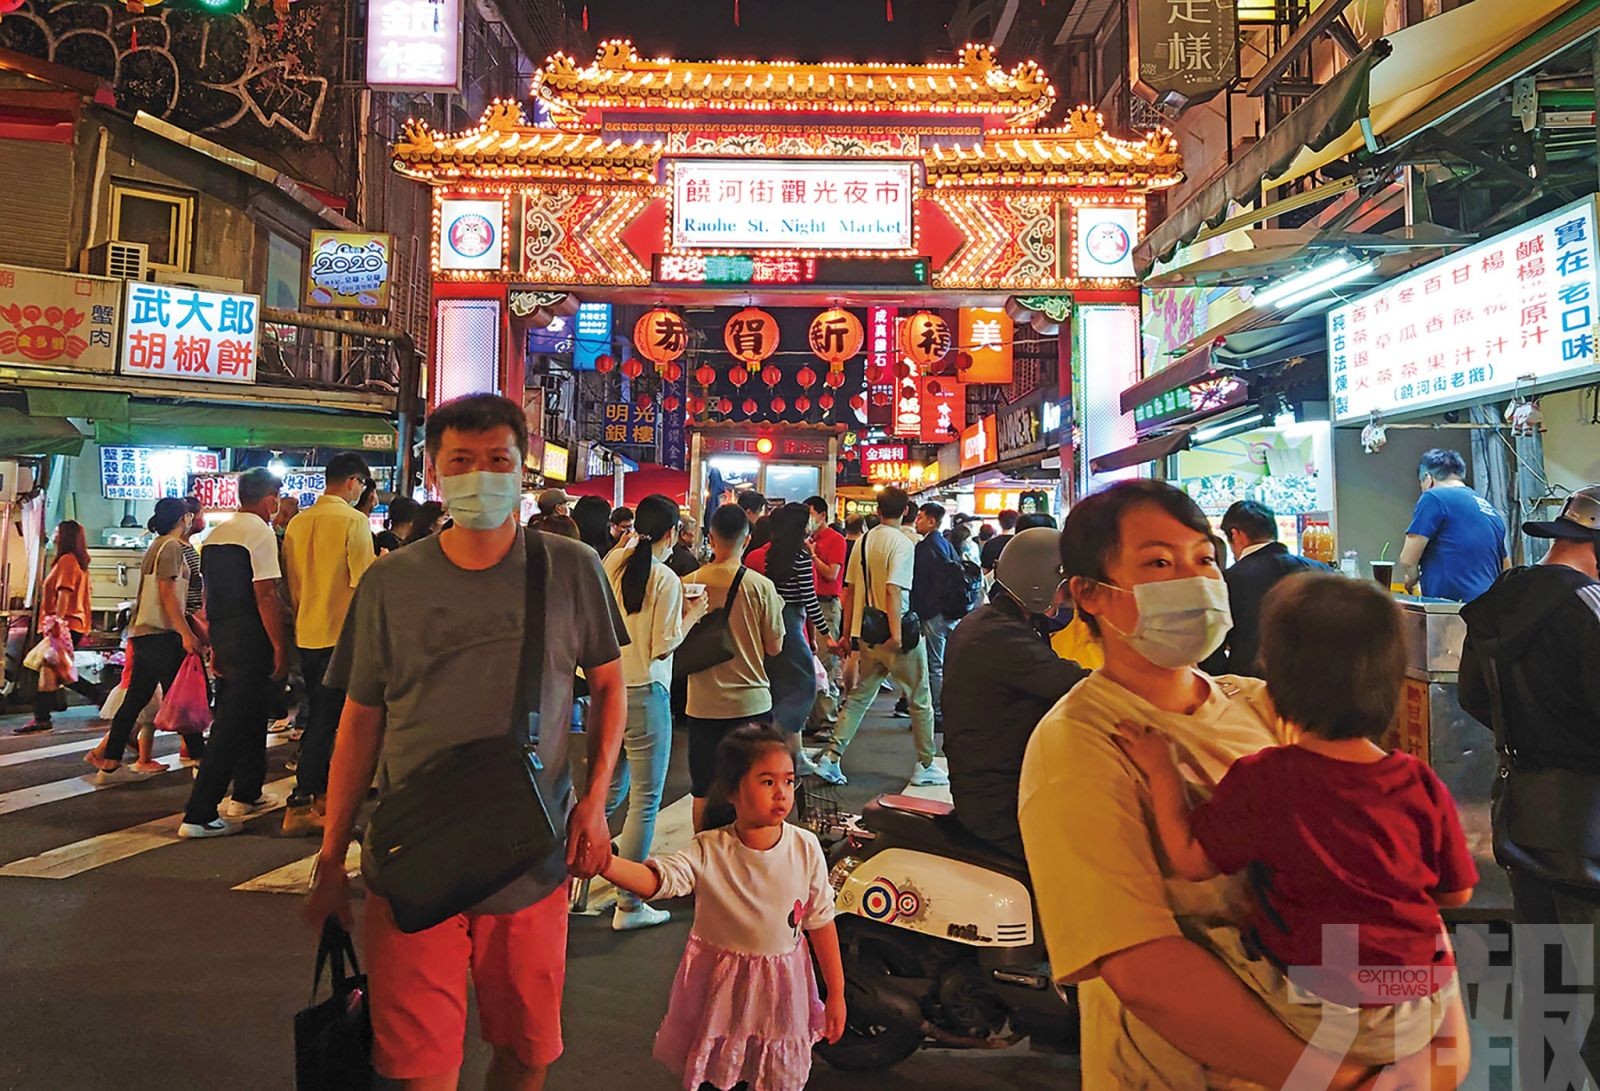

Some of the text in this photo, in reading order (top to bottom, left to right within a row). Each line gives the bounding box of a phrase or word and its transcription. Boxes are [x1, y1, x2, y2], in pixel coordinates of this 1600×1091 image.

[686, 179, 901, 205] 饒河街觀光夜市
[684, 218, 901, 235] Raohe St. Night Market
[314, 254, 383, 275] 2020
[1554, 216, 1593, 361] 實在老口味
[90, 304, 114, 348] 蟹肉
[131, 287, 254, 335] 武大郎
[970, 307, 1003, 352] 美
[1423, 275, 1447, 369] 百香果
[129, 330, 253, 377] 胡椒餅
[729, 319, 765, 355] 賀
[810, 317, 849, 353] 新
[1351, 306, 1370, 391] 苦茶退火
[1397, 287, 1418, 380] 冬瓜茶
[605, 425, 655, 443] 銀樓
[866, 448, 904, 461] 金瑞利
